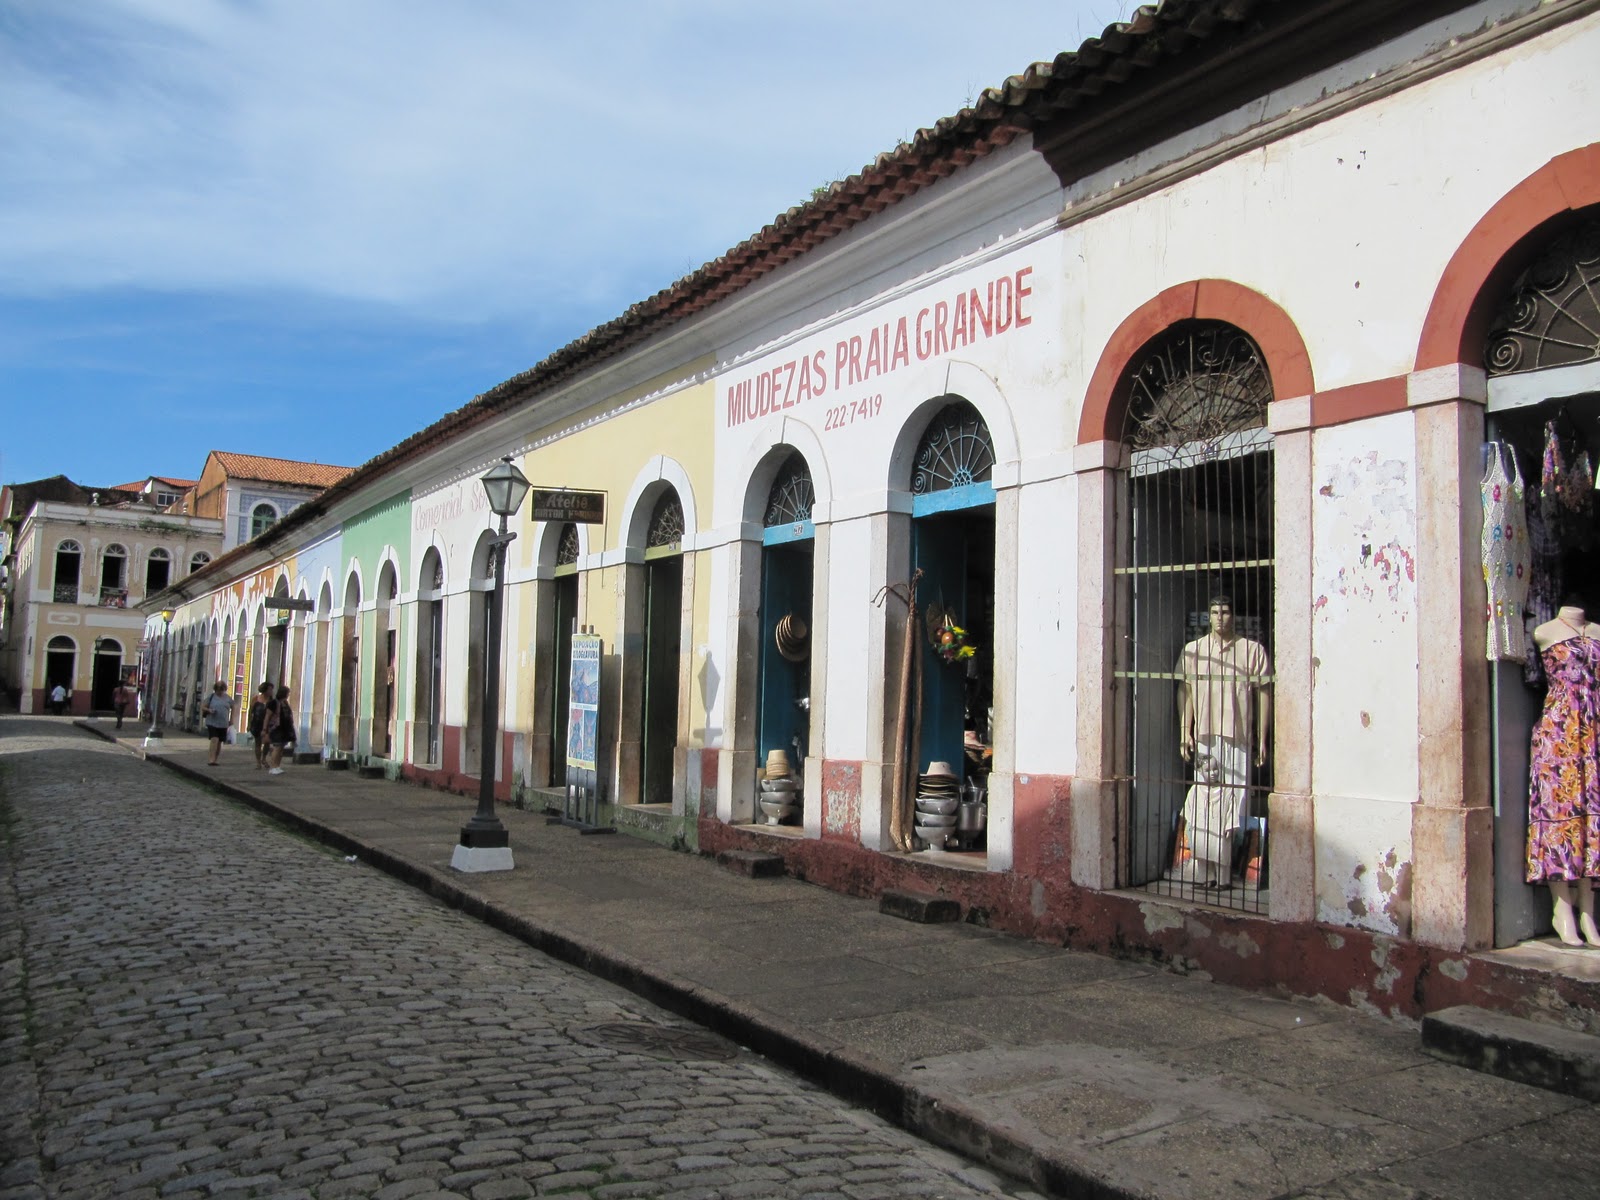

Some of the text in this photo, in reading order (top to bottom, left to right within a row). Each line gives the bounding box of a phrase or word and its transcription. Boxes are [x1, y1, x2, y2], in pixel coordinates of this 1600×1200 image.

[727, 265, 1033, 428] MIUDEZAS PRAIA GRANDE
[415, 486, 464, 532] Comercial
